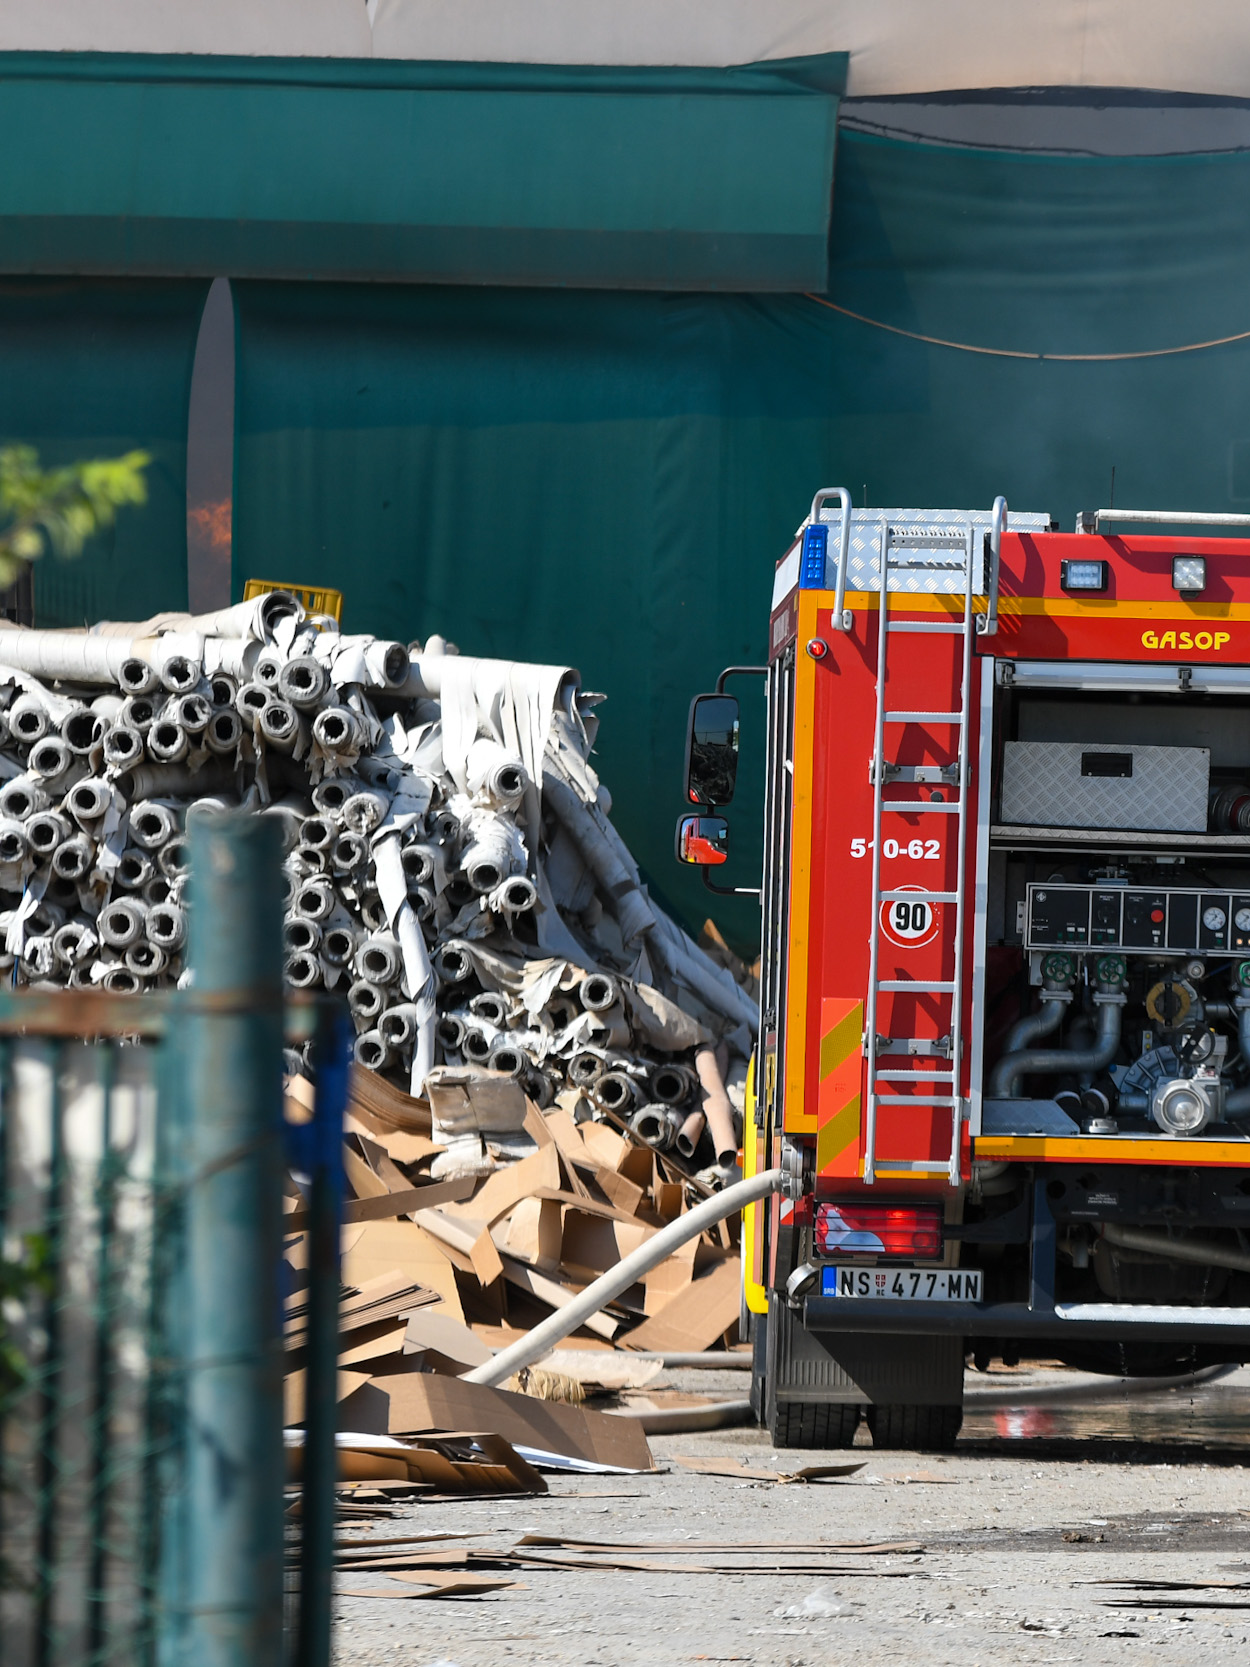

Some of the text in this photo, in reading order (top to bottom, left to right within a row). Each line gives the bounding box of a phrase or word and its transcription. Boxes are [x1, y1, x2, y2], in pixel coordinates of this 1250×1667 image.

[1141, 630, 1231, 650] GASOP
[896, 902, 926, 930] 90
[841, 1271, 870, 1296] NS
